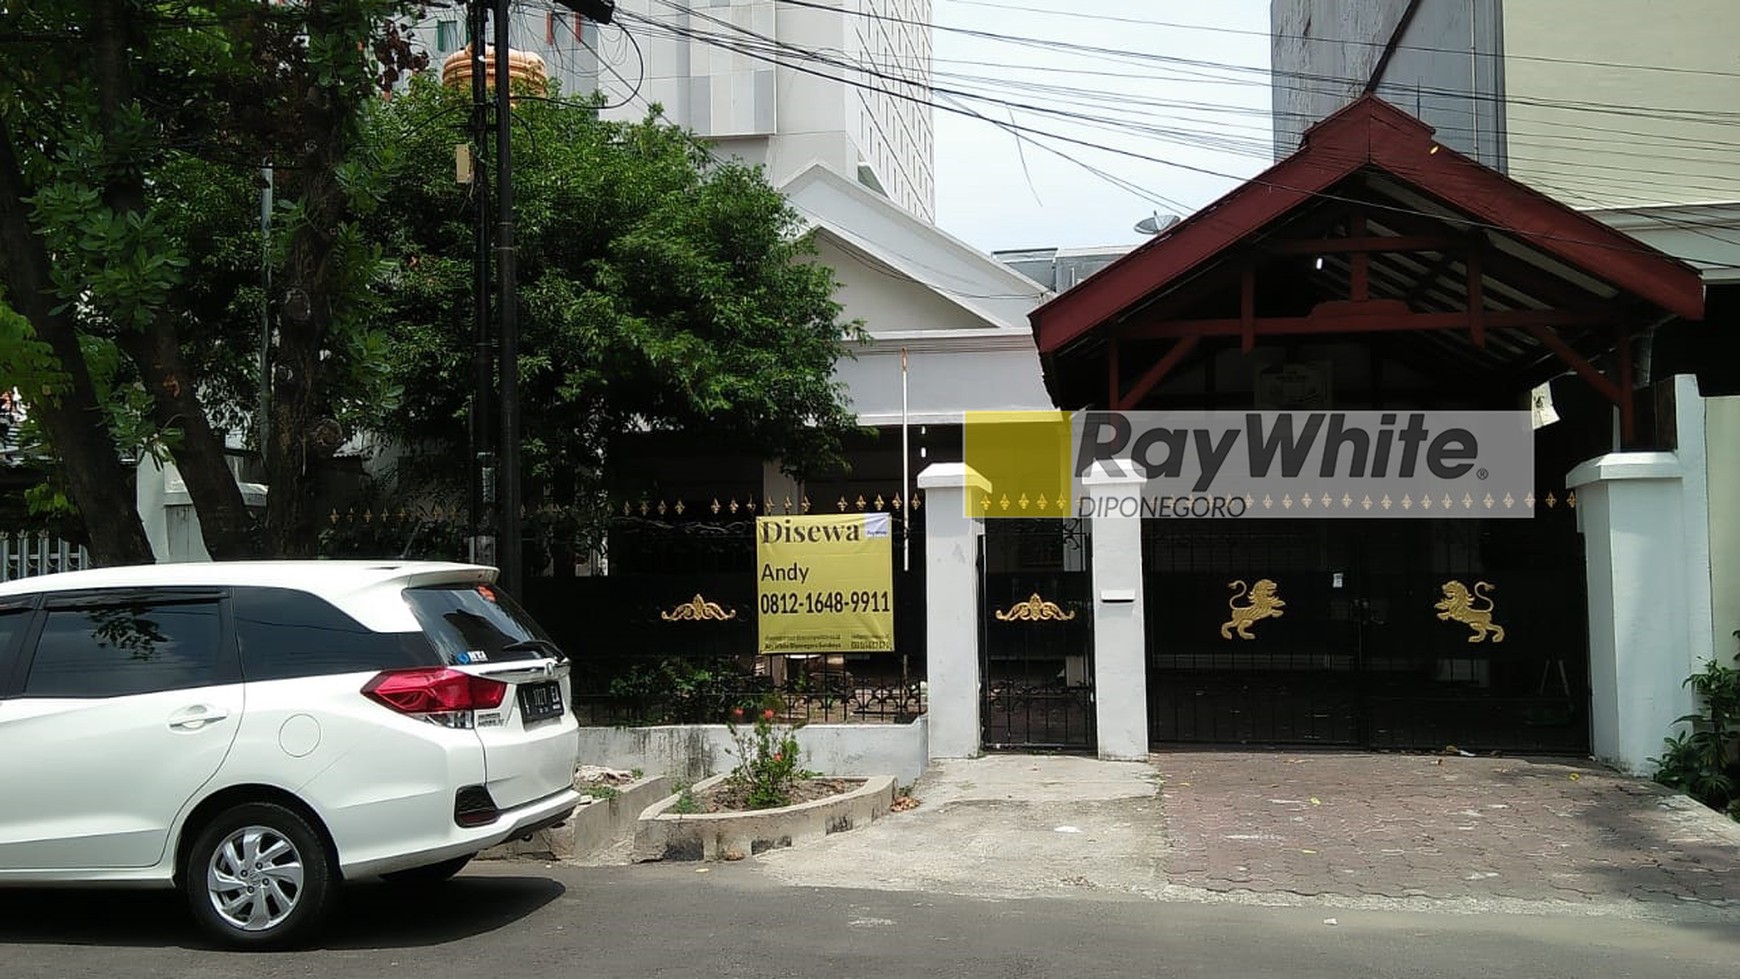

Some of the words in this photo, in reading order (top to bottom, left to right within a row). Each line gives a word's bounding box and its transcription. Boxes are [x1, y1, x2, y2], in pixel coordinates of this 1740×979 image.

[762, 519, 860, 543] Disewa
[761, 562, 809, 584] Andy
[761, 591, 890, 615] 0812-1648-9911
